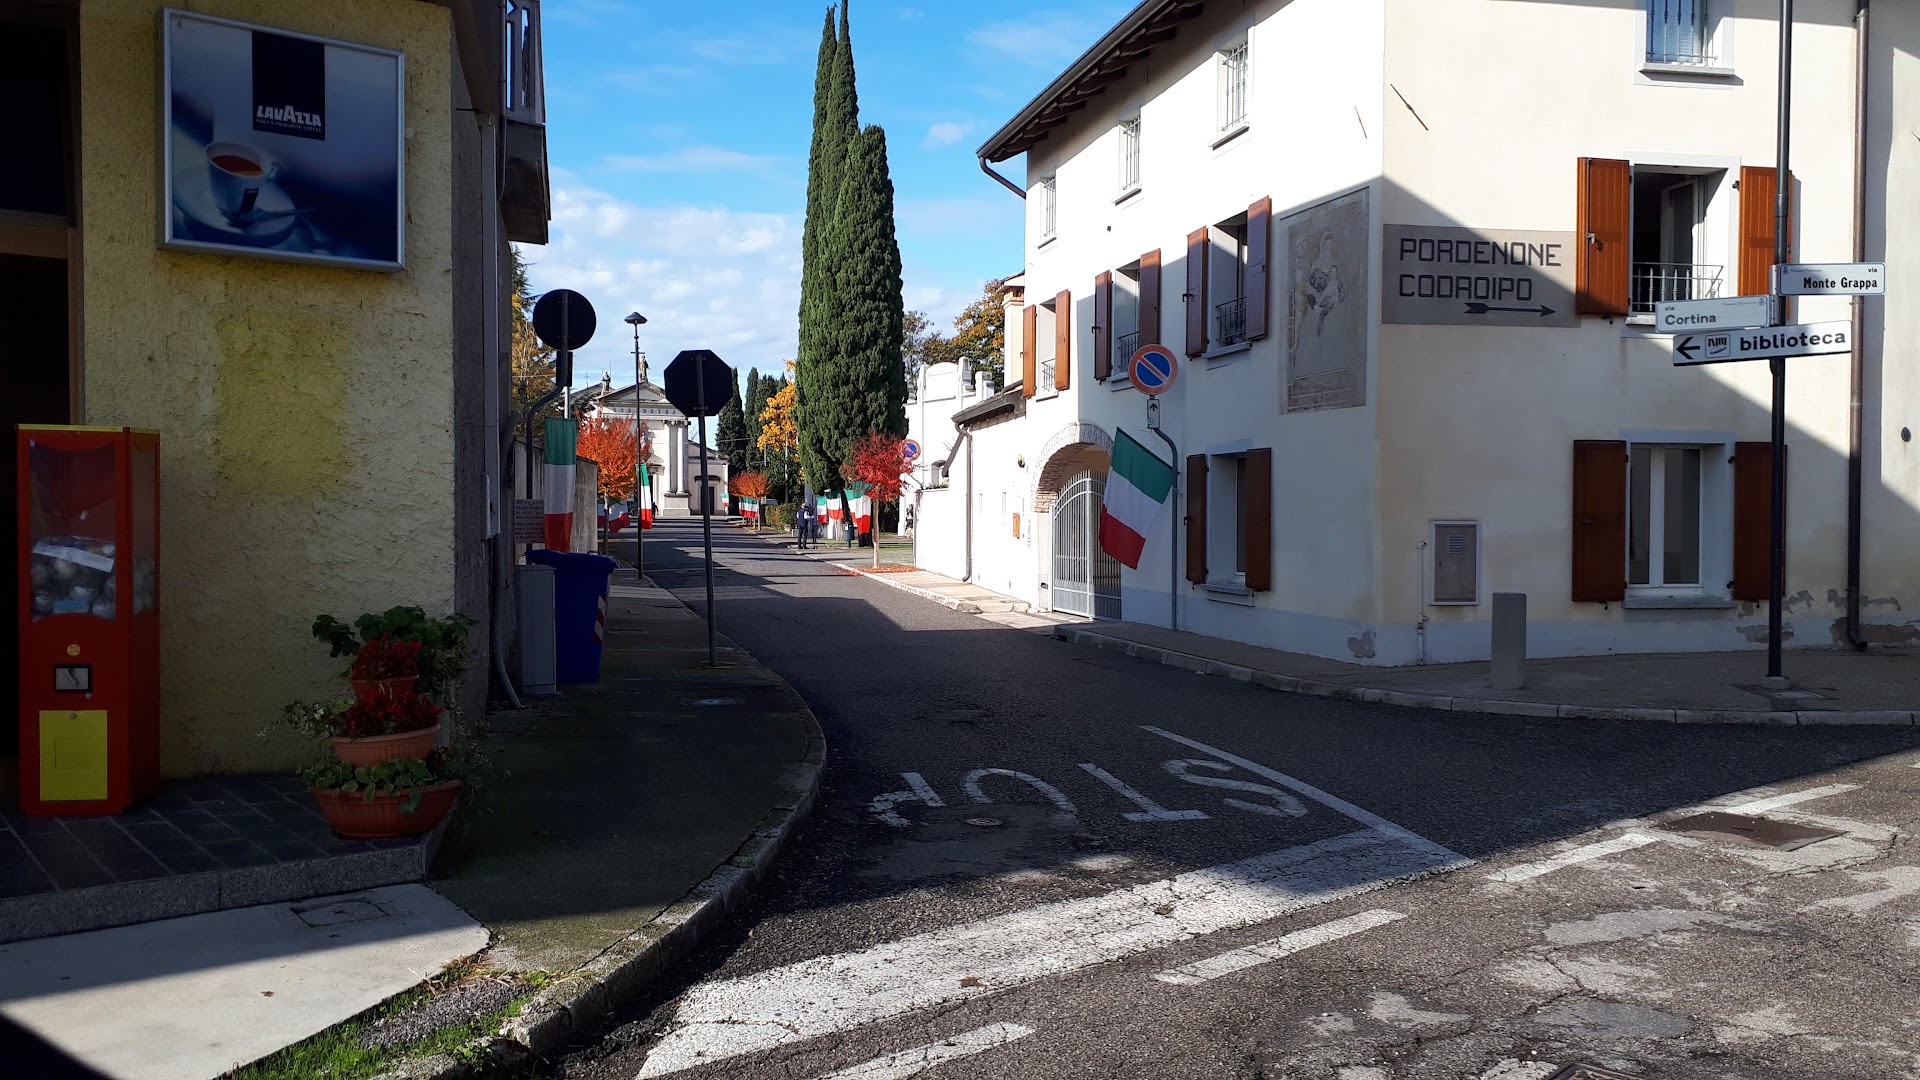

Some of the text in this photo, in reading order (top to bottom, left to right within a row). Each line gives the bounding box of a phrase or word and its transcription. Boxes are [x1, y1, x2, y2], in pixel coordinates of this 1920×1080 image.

[256, 105, 322, 127] LAVAZZA
[1400, 238, 1562, 267] PORDENONE
[1399, 274, 1532, 301] CODROIPO
[1803, 277, 1878, 290] Monte Grappa
[1665, 313, 1717, 326] Cortina
[1740, 331, 1846, 352] biblioteca
